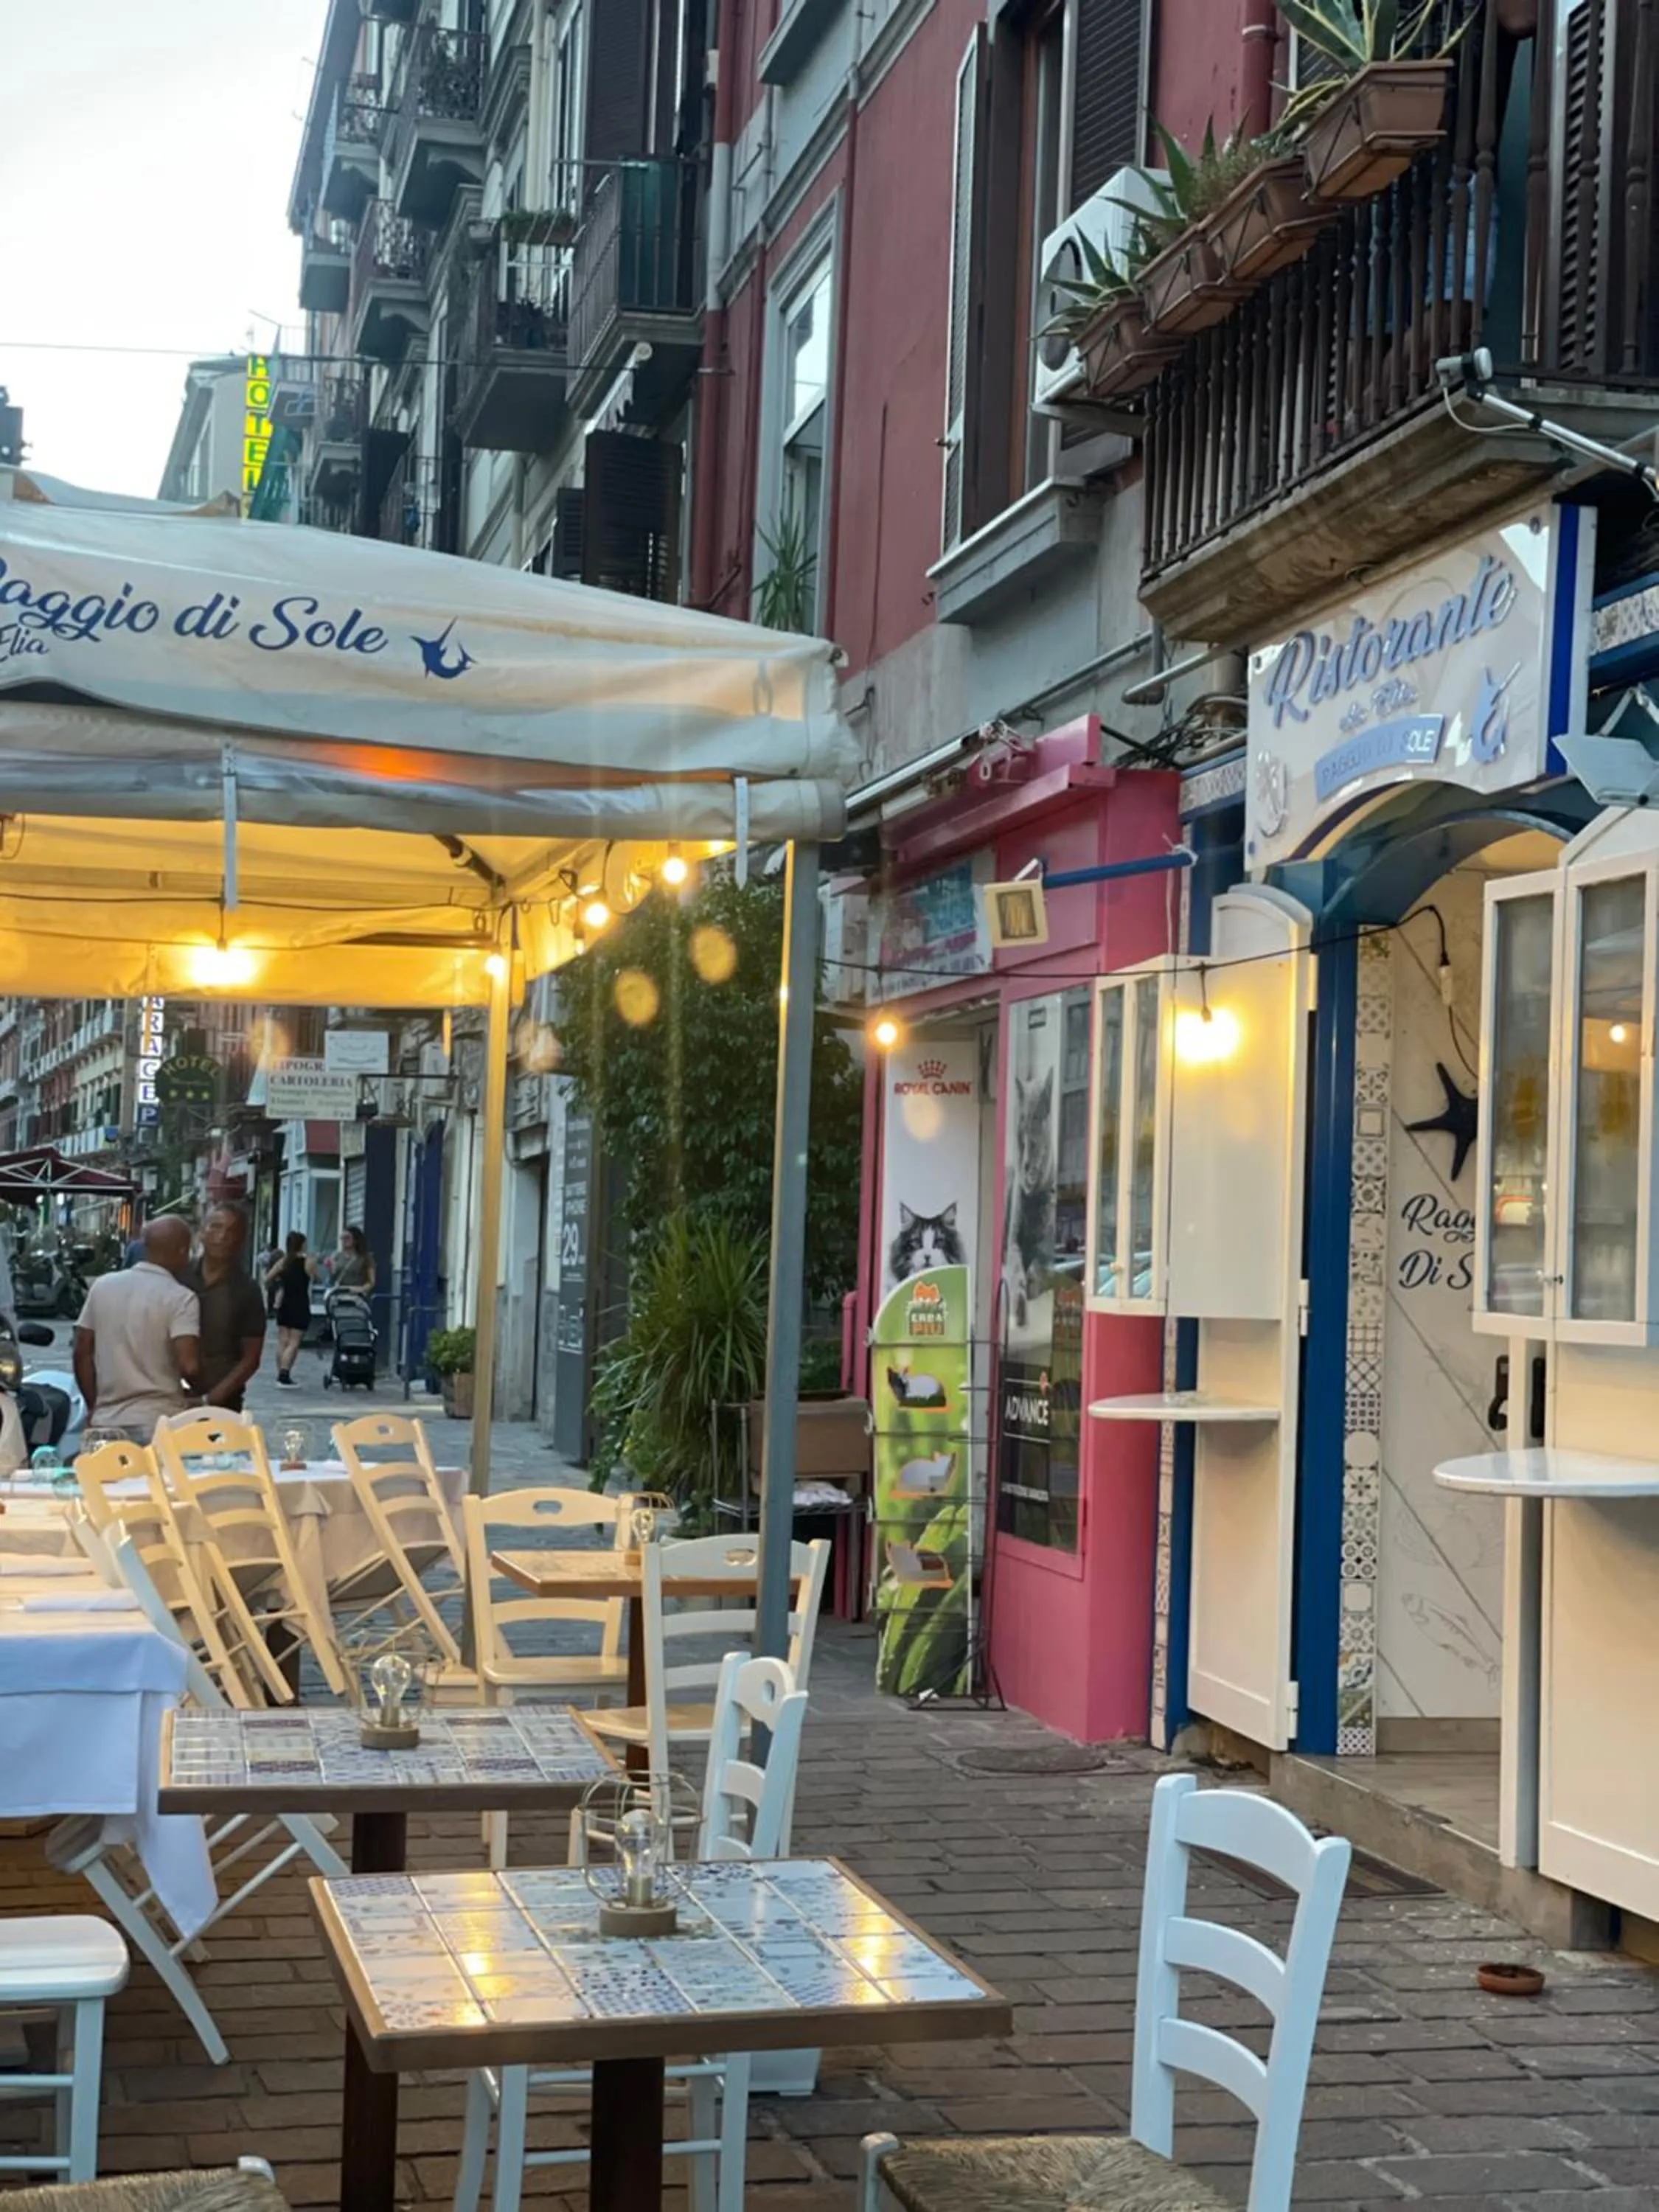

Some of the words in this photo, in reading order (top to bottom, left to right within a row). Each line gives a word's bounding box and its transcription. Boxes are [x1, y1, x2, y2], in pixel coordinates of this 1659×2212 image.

[247, 355, 270, 493] HOTEL
[173, 592, 240, 639] di
[249, 597, 389, 653] Sole
[1264, 554, 1517, 730] Ristorante
[163, 1055, 220, 1079] HOTEL
[270, 1076, 353, 1088] CARTOLERIA
[894, 1081, 930, 1095] ROYAL
[932, 1081, 971, 1095] CANIN
[1401, 1193, 1475, 1244] Rag
[563, 1222, 580, 1266] 29
[1399, 1250, 1441, 1289] Di
[1447, 1251, 1474, 1290] S
[1004, 1396, 1049, 1426] ADVANCE
